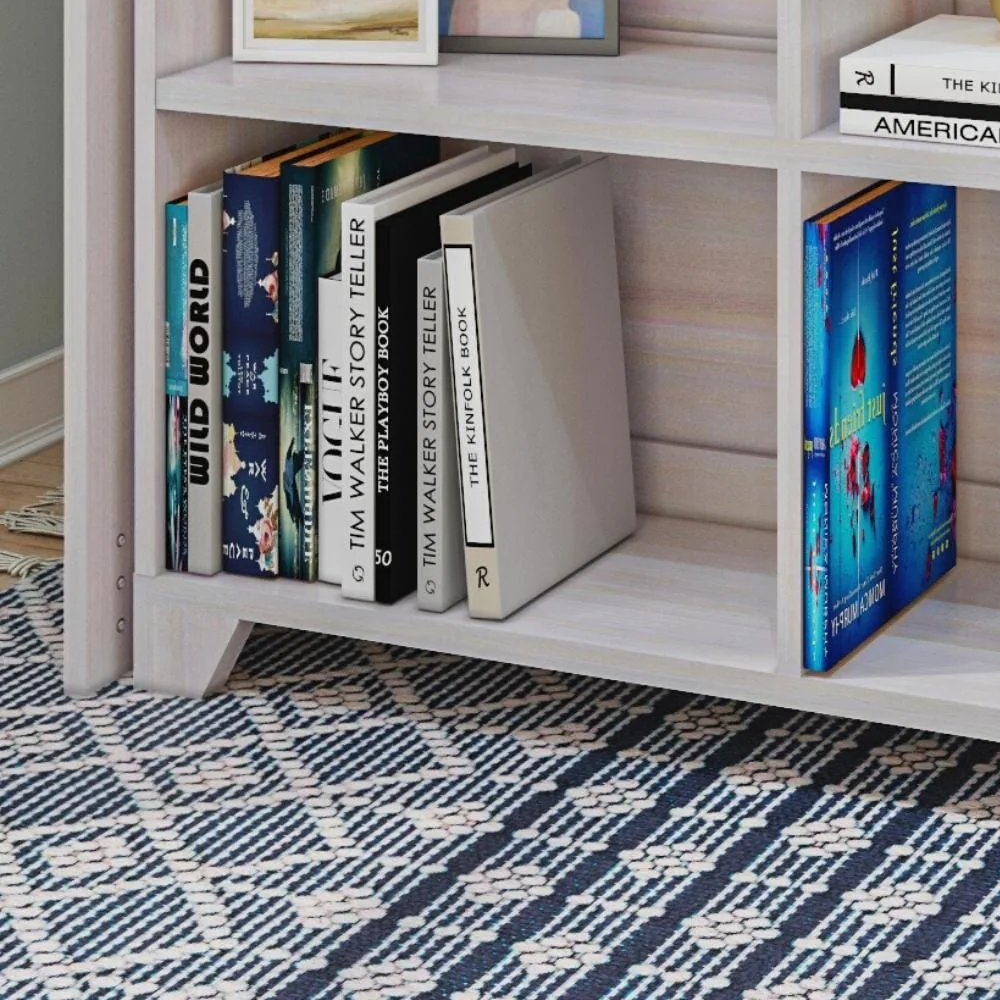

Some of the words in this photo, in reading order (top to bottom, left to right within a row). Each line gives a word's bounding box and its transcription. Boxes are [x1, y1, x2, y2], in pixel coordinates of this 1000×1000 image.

[942, 77, 973, 92] THE
[350, 218, 365, 299] TELLER
[189, 258, 210, 386] WORLD
[350, 307, 366, 389] STORY
[377, 305, 389, 361] BOOK
[422, 286, 436, 354] TELLER
[457, 306, 470, 358] BOOK
[377, 366, 389, 452] PLAYBOY
[422, 361, 436, 430] STORY
[461, 366, 477, 444] KINFOLK
[189, 398, 210, 486] WILD
[350, 396, 365, 499] WALKER
[377, 456, 389, 493] THE
[467, 452, 480, 488] THE
[422, 437, 436, 523] WALKER
[350, 509, 365, 550] TIM
[422, 533, 436, 567] TIM
